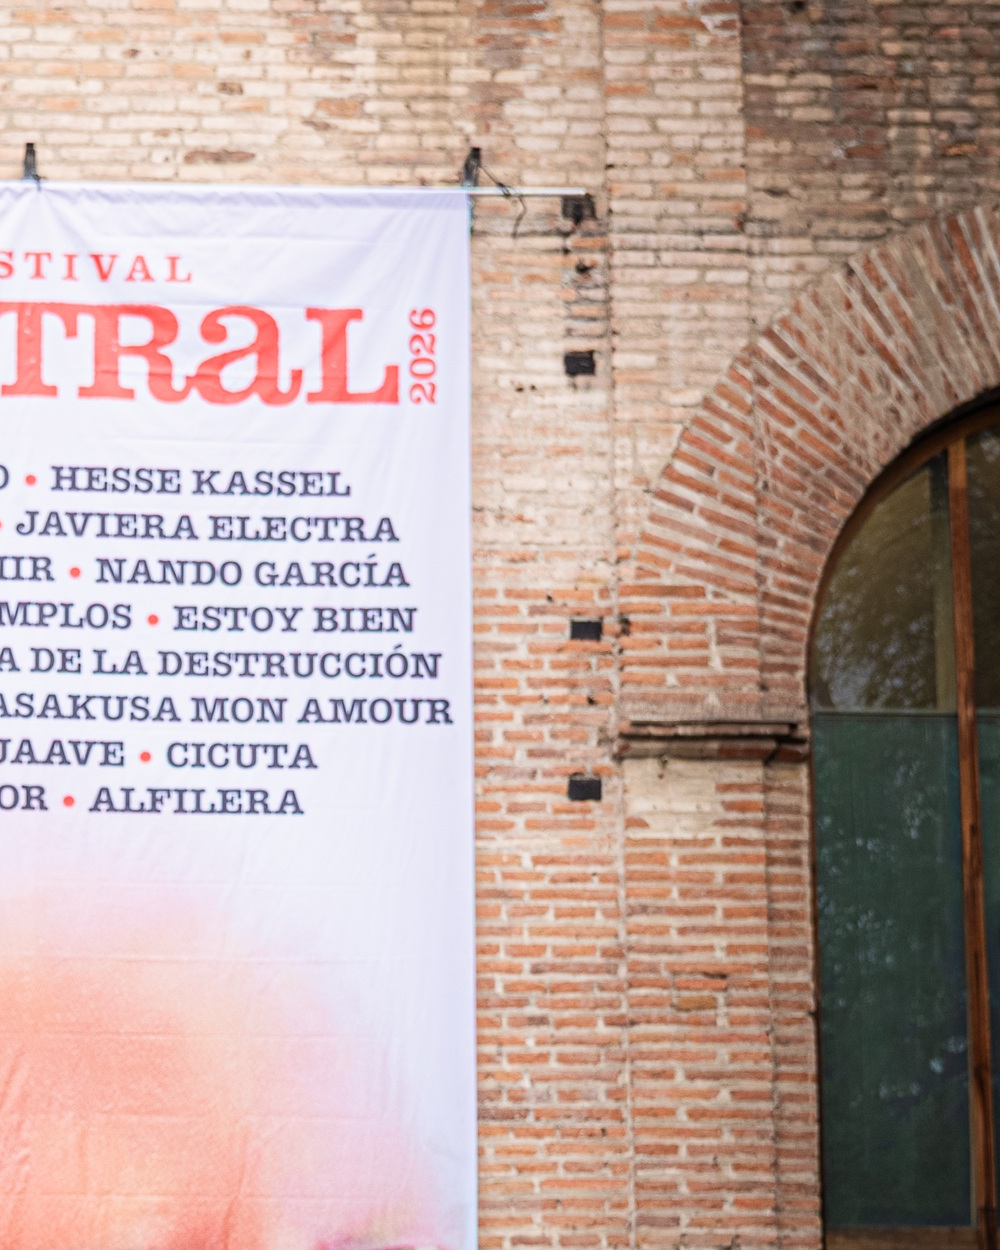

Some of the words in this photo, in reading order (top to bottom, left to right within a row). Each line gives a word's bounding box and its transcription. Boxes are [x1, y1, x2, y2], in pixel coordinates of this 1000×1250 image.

[408, 308, 437, 405] 2026
[50, 466, 182, 494] HESSE
[191, 470, 352, 496] KASSEL
[14, 510, 200, 540] JAVIERA
[208, 515, 401, 542] ELECTRA
[95, 558, 243, 586] NANDO
[253, 554, 411, 588] GARCÍA
[172, 605, 304, 632] ESTOY
[312, 607, 419, 632] BIEN
[29, 647, 83, 674] DE
[91, 649, 149, 675] LA
[156, 644, 443, 678] DESTRUCCIÓN
[190, 697, 289, 723] MON
[296, 698, 455, 724] AMOUR
[166, 742, 319, 769] CICUTA
[87, 787, 306, 815] ALFILERA
